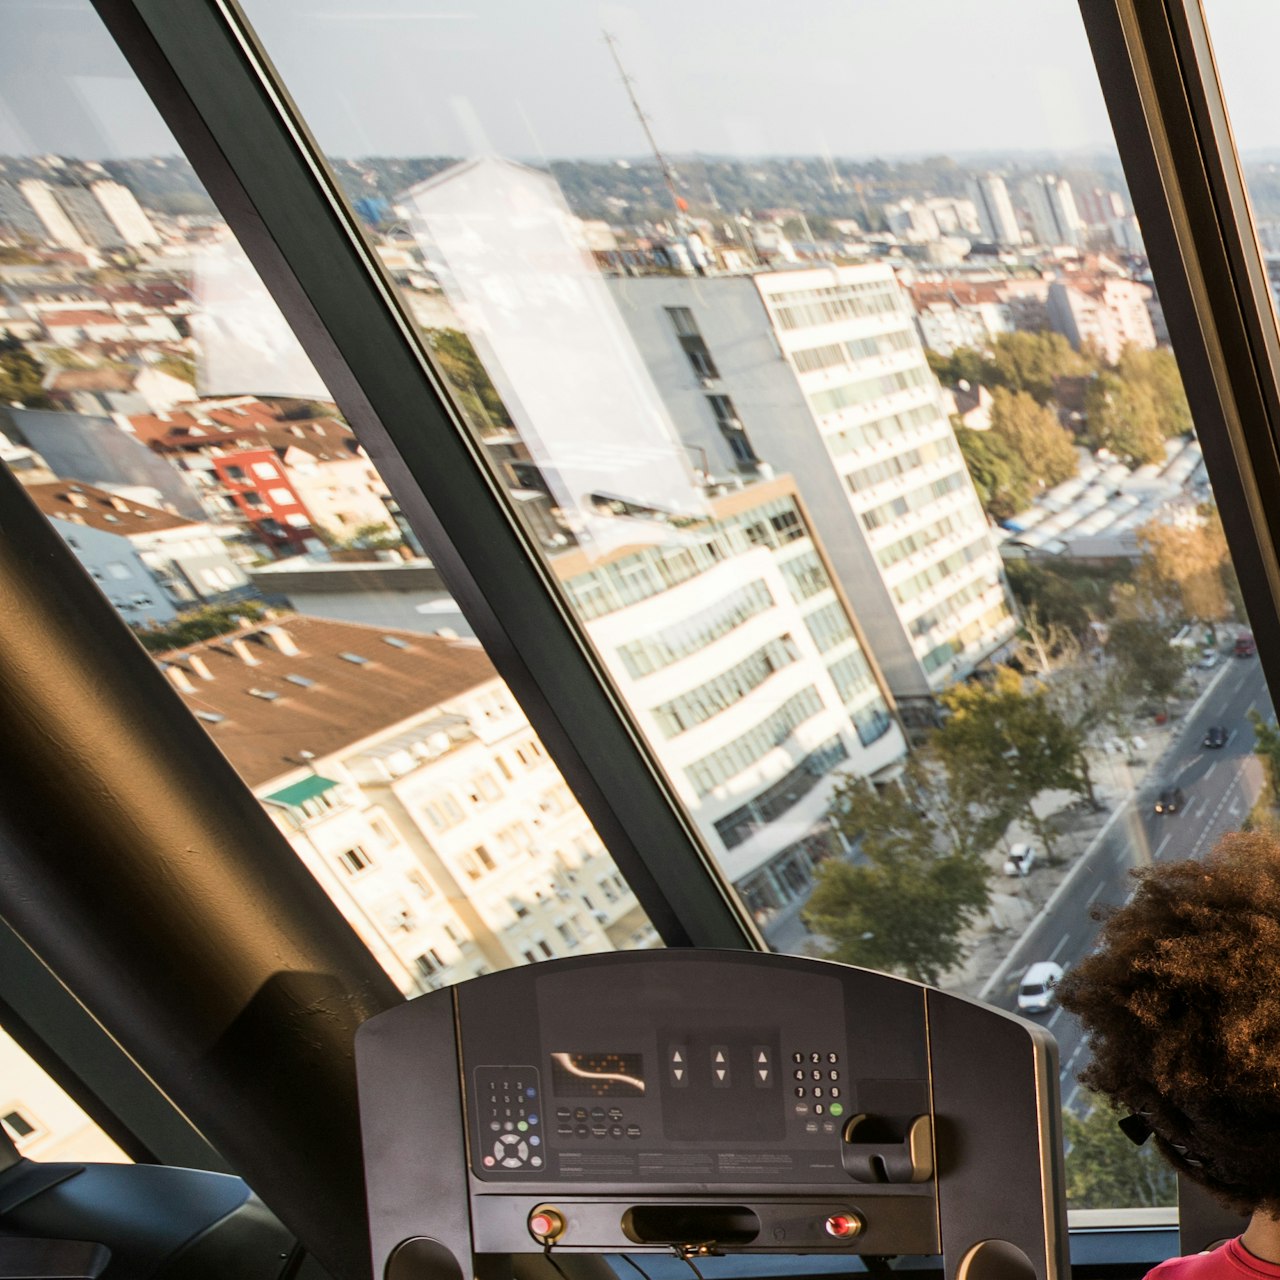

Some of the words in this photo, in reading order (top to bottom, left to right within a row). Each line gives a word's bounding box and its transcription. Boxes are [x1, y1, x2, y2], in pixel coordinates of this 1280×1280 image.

[795, 1054, 801, 1063] 1
[812, 1054, 819, 1063] 2
[830, 1054, 836, 1063] 3
[796, 1070, 803, 1080] 4
[813, 1070, 820, 1080] 5
[831, 1070, 837, 1080] 6
[798, 1087, 804, 1097] 7
[815, 1087, 821, 1097] 8
[832, 1087, 838, 1097] 9
[815, 1104, 822, 1114] 0
